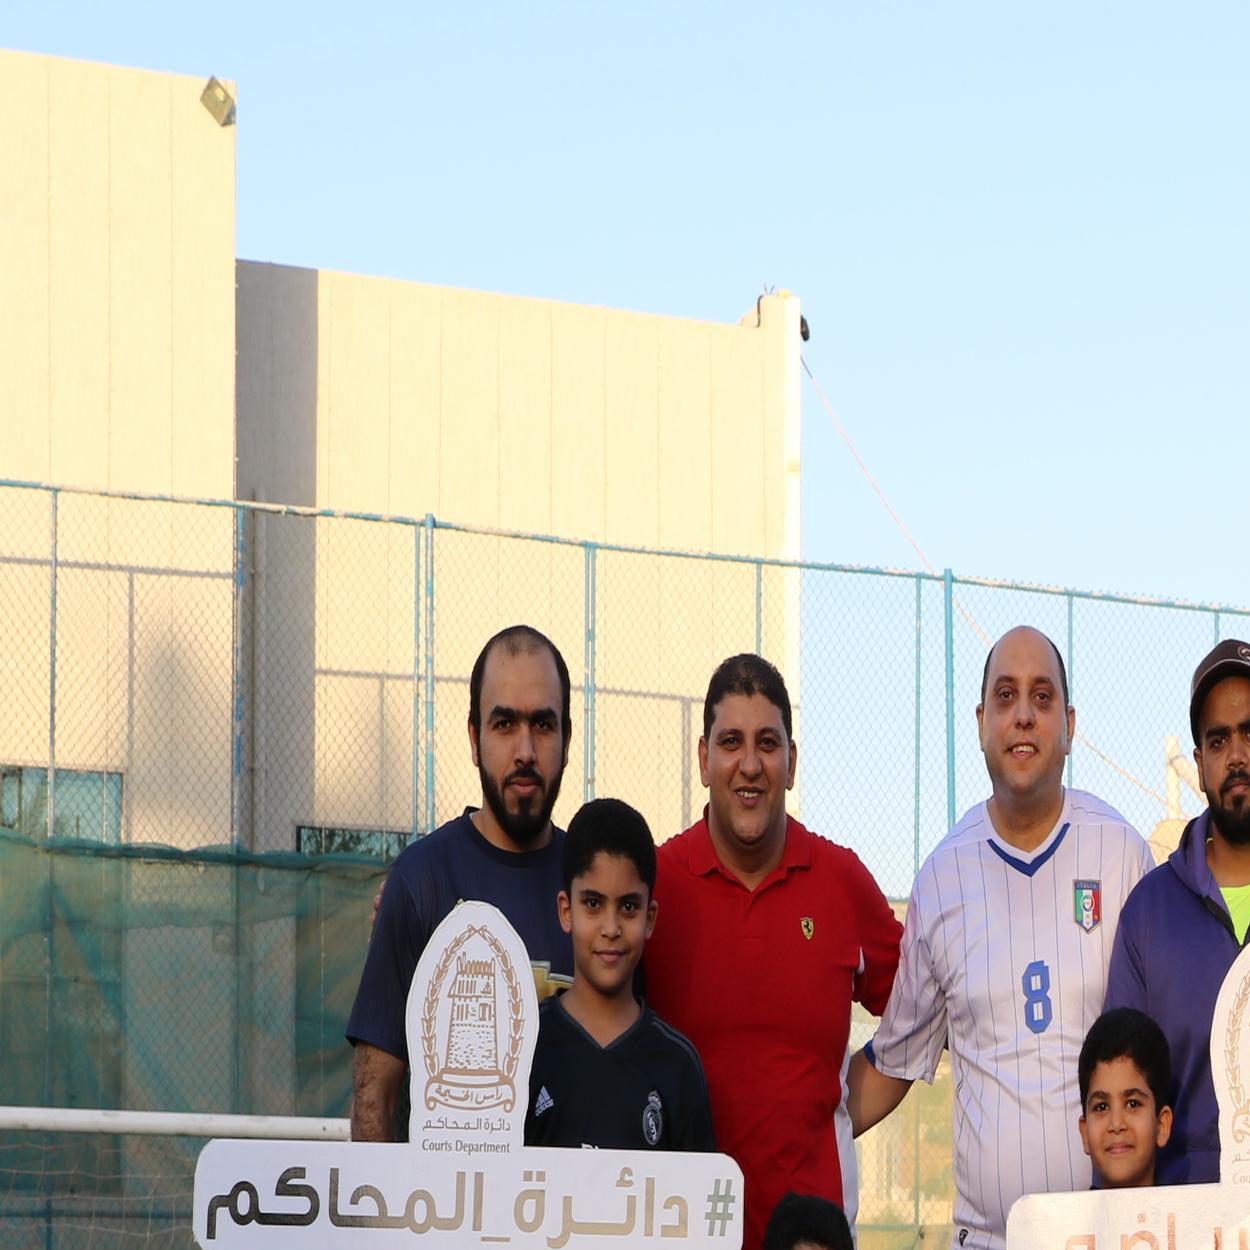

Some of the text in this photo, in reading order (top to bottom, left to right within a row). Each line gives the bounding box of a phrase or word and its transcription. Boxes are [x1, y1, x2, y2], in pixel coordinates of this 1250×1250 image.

[1021, 960, 1053, 1034] 8
[421, 1138, 511, 1156] Courts Department
